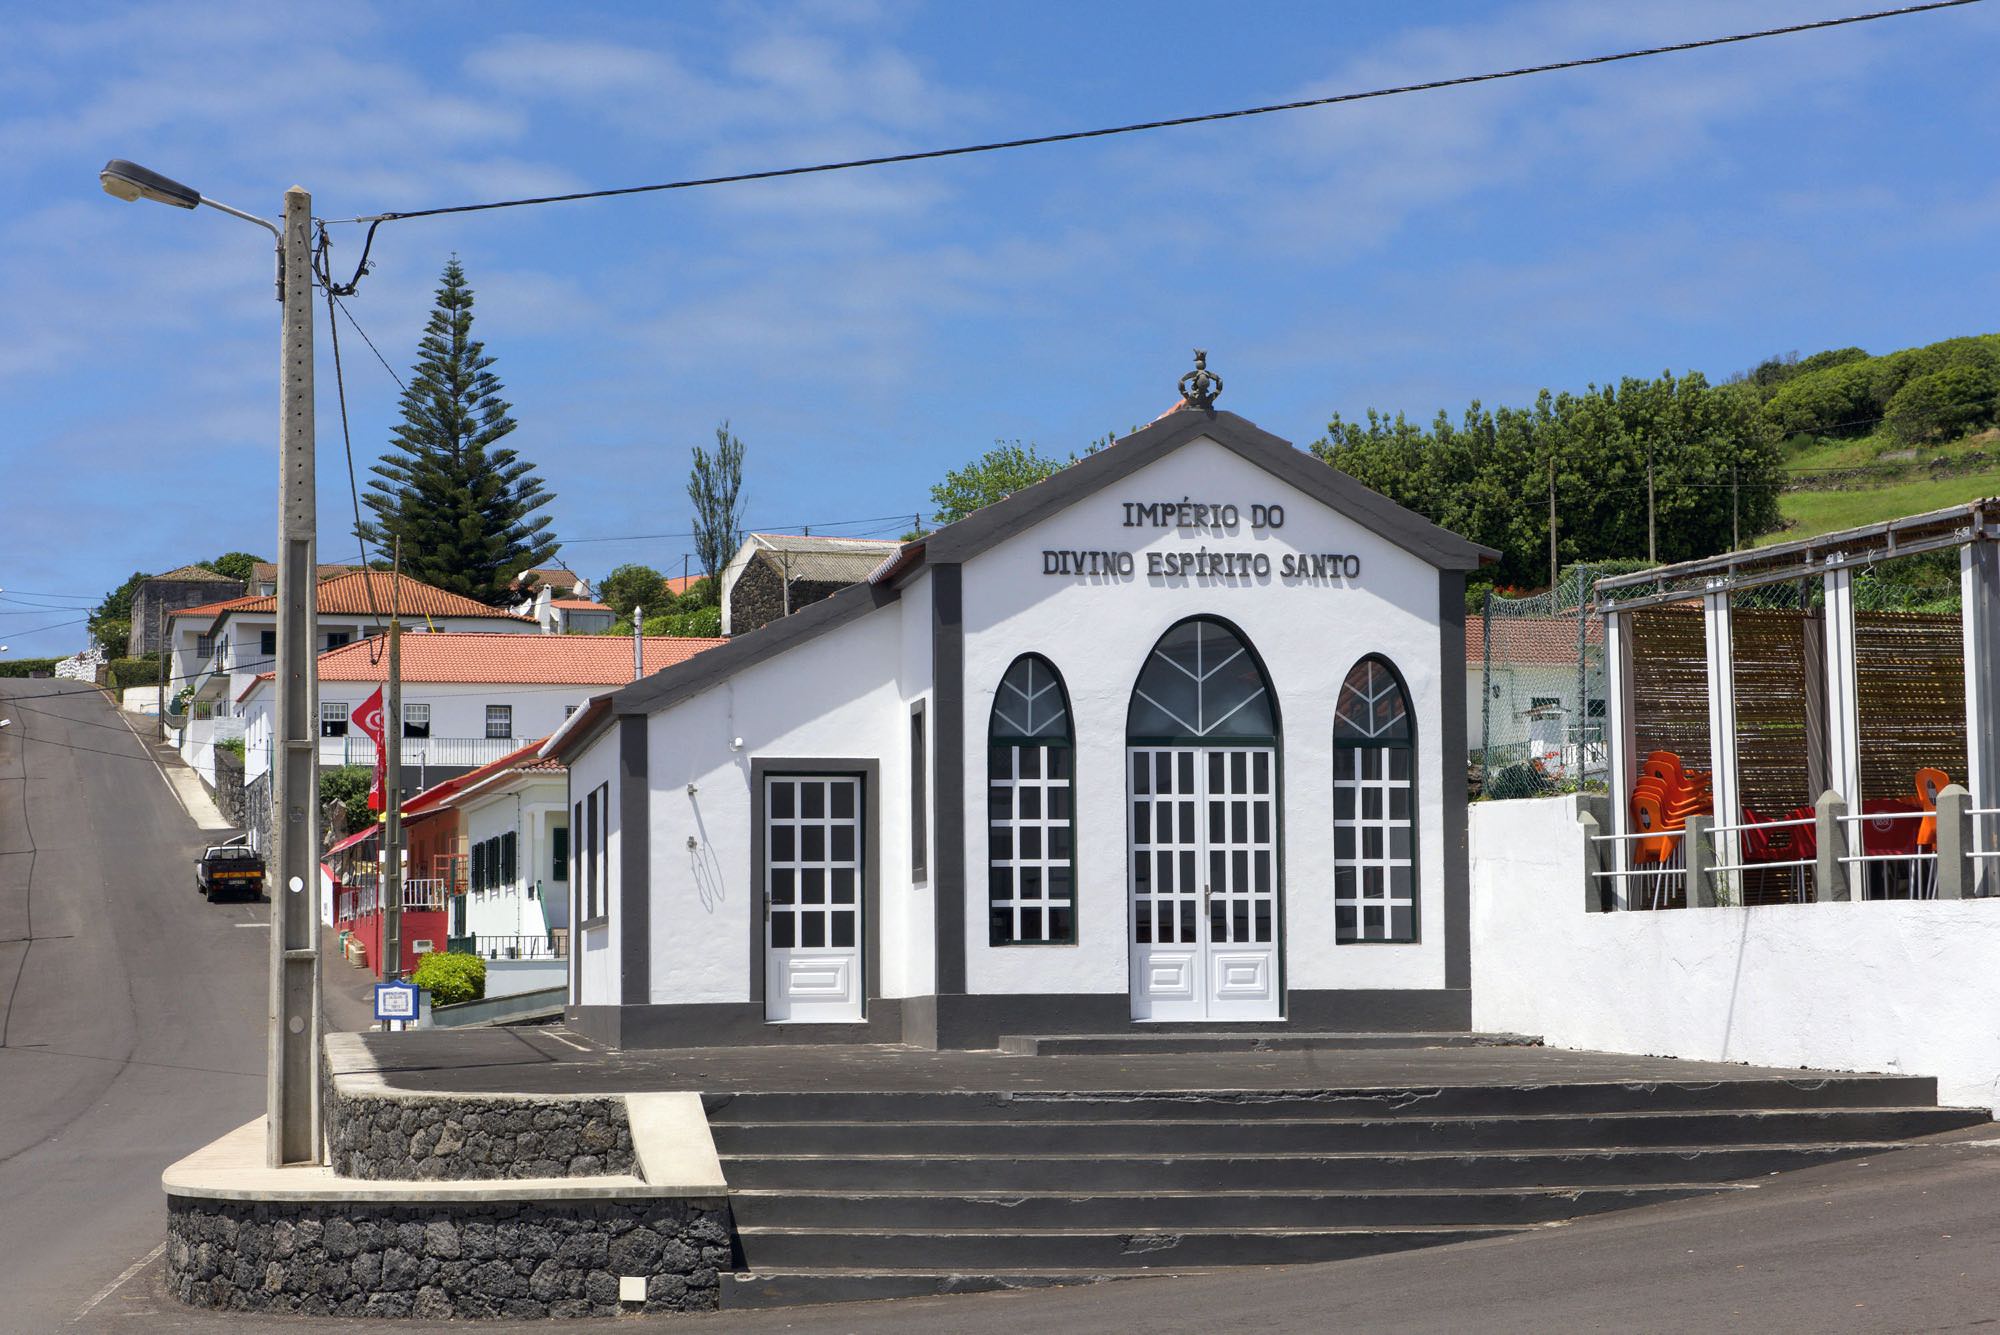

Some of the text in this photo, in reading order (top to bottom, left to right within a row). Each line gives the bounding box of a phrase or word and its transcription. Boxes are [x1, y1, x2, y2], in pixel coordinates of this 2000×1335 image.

[1122, 496, 1284, 529] IMPÉRIO DO
[1042, 545, 1361, 578] DIVINO ESPÍRITO SANTO
